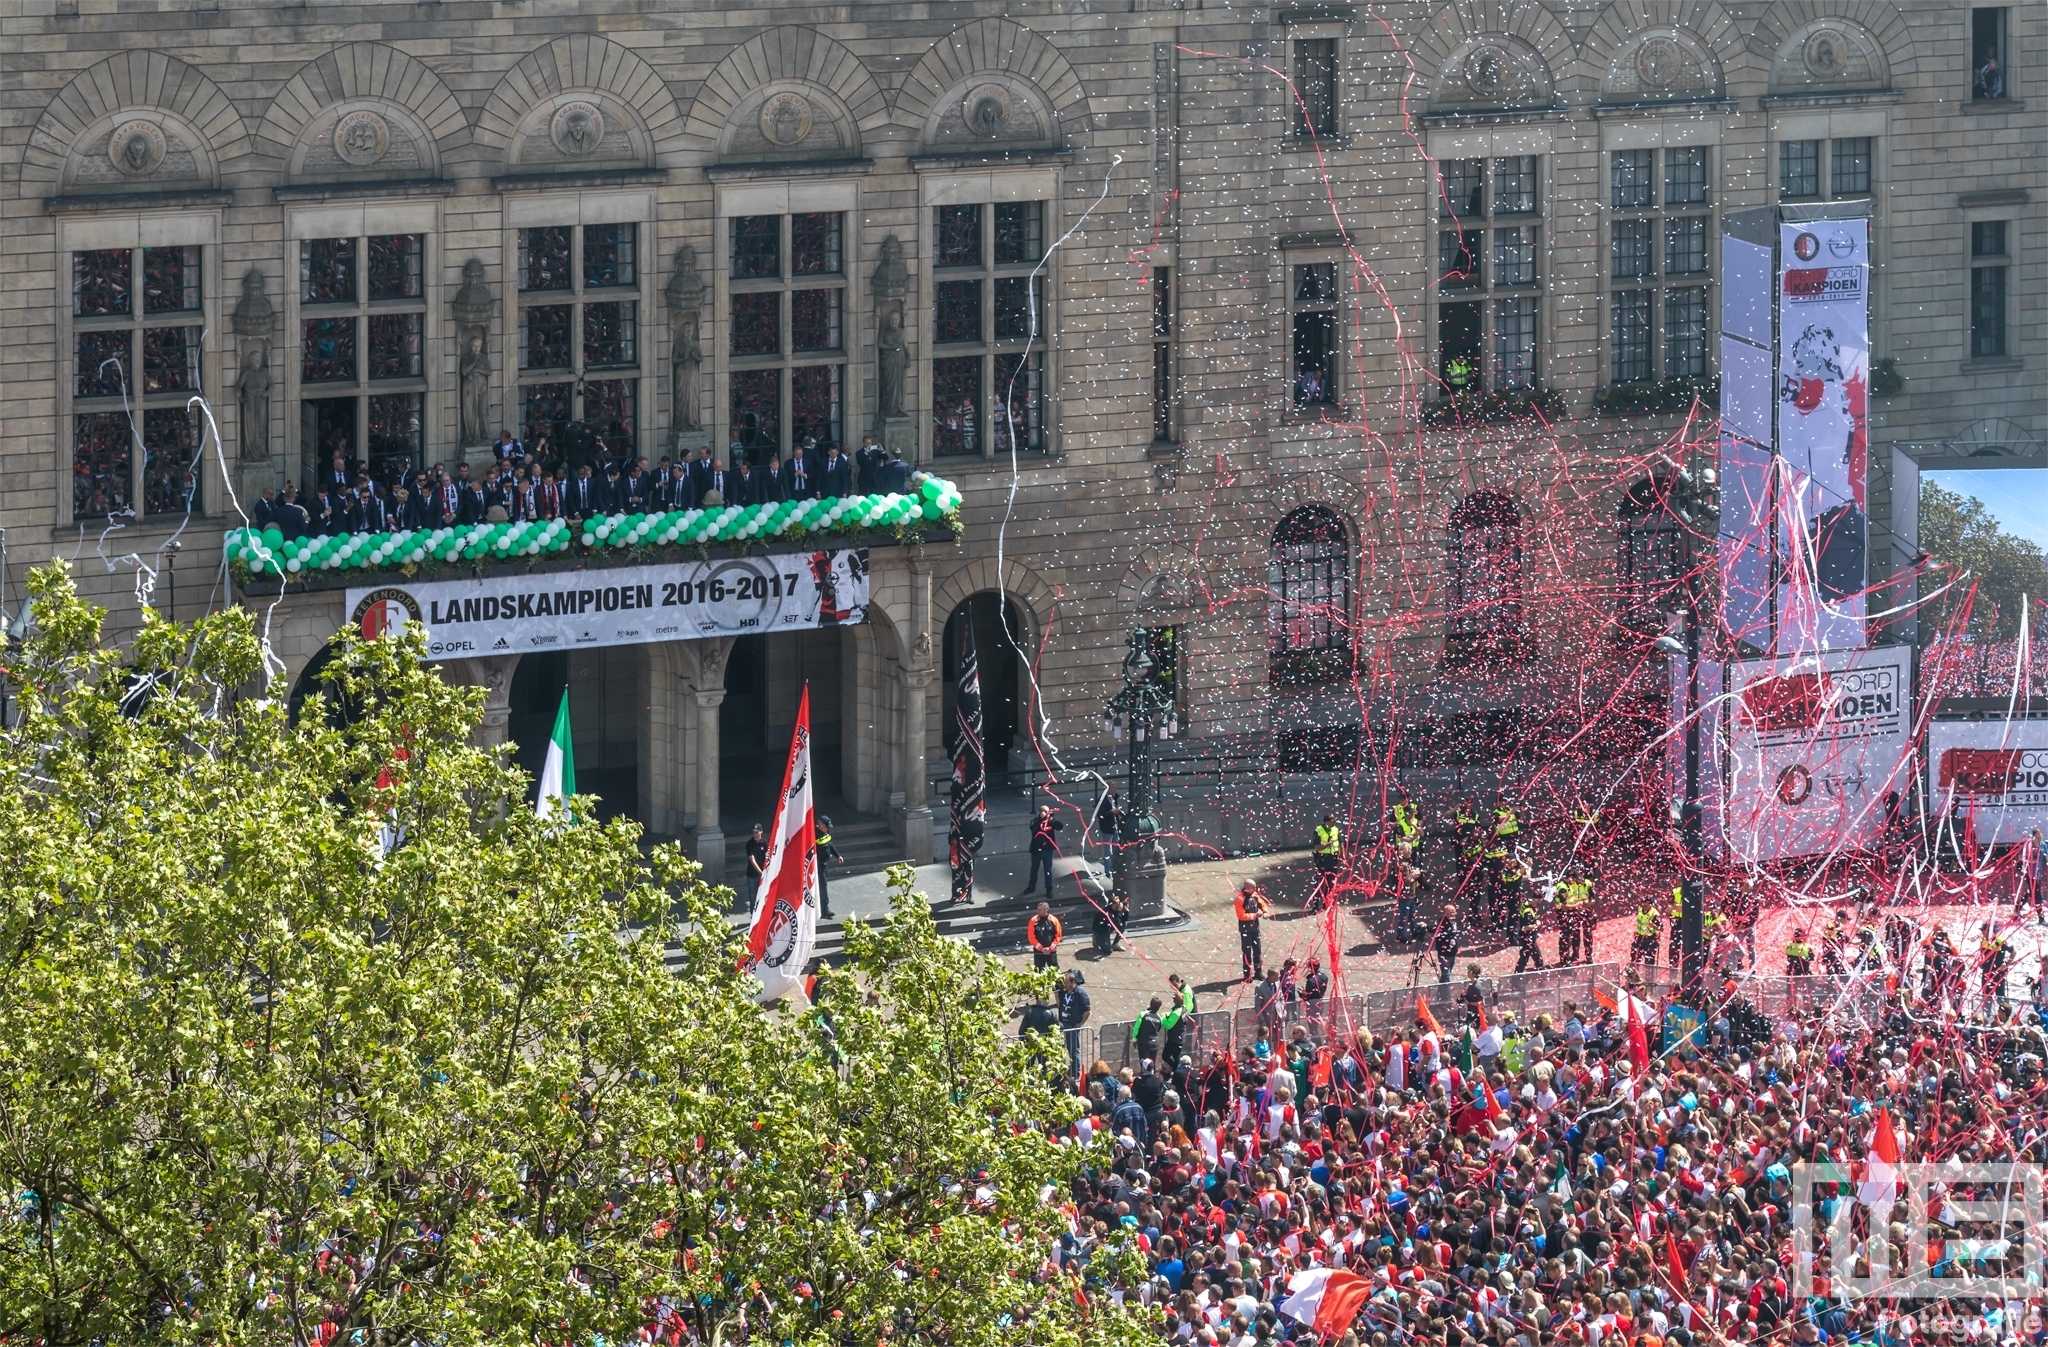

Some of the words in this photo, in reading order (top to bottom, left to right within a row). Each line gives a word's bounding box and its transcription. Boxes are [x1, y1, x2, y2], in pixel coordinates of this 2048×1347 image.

[559, 104, 595, 118] ERASMUS
[340, 113, 384, 131] MERCATURA
[136, 122, 160, 139] VEKEN
[1794, 269, 1858, 281] FEYENOORD
[1794, 279, 1857, 292] KAMPIOEN
[355, 590, 417, 617] FEYENOORD
[431, 583, 653, 625] LANDSKAMPIOEN
[661, 573, 799, 606] 2016-2017
[740, 618, 760, 627] HDI
[446, 641, 475, 651] OPEL
